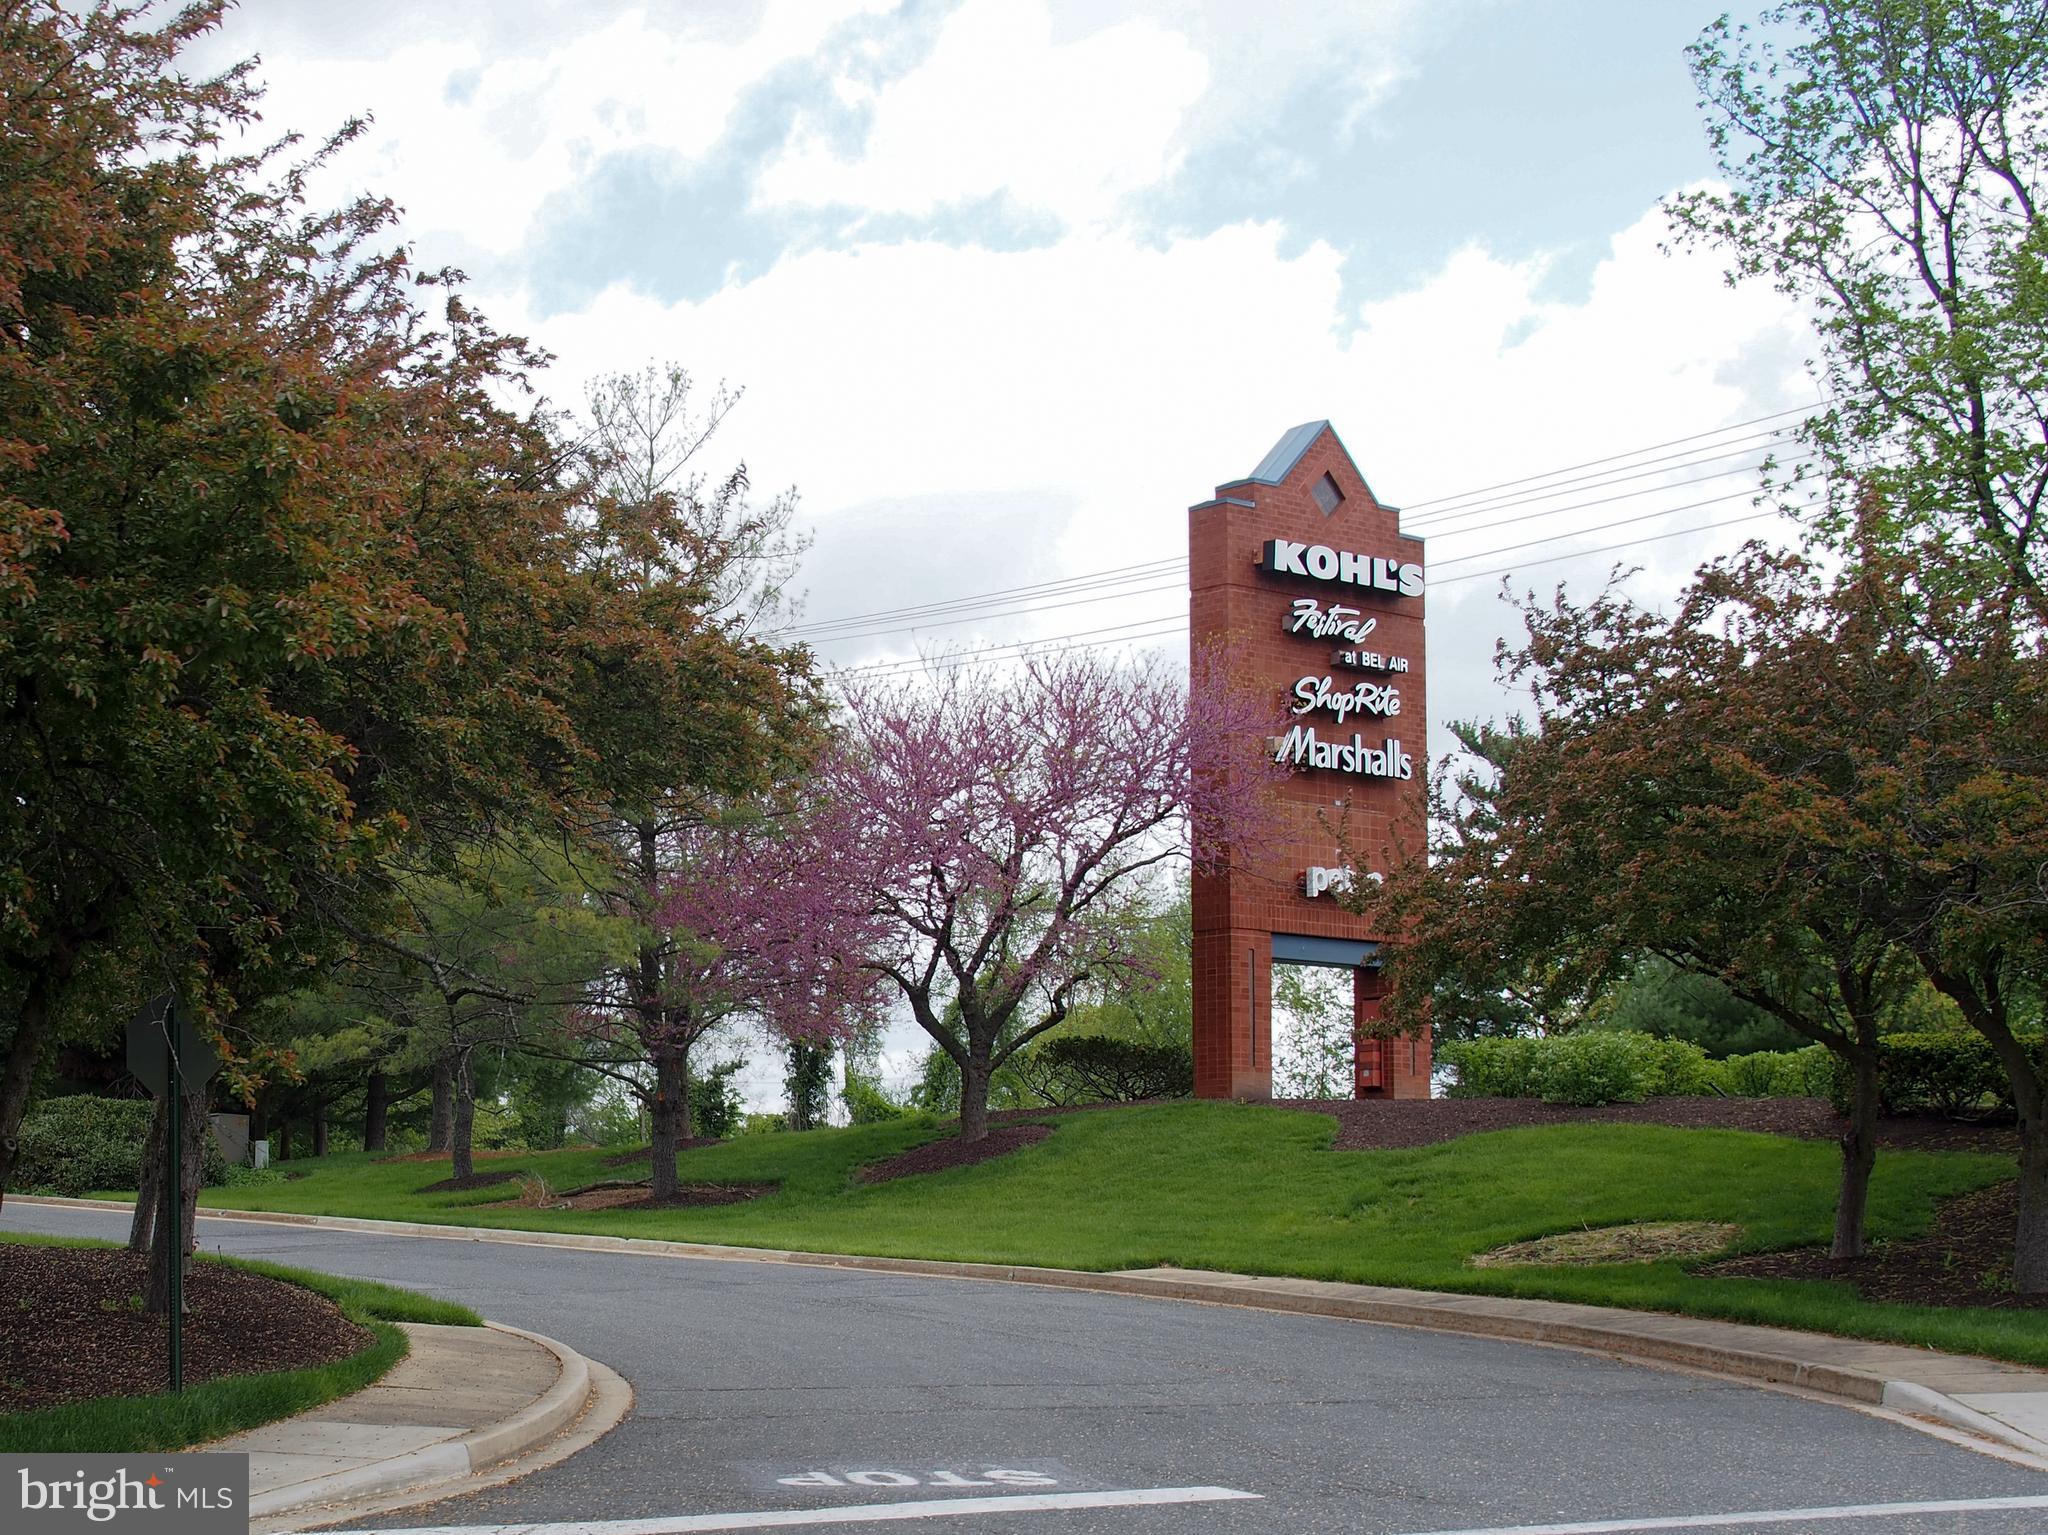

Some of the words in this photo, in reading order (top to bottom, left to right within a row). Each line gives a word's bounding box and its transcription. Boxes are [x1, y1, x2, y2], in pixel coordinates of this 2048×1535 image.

[1273, 538, 1425, 597] KOHL'S
[1292, 598, 1376, 644] Festival
[1344, 650, 1357, 665] at
[1361, 651, 1385, 669] BEL
[1388, 656, 1409, 673] AIR
[1292, 675, 1401, 724] ShopRite
[1274, 725, 1412, 780] Marshalls
[776, 1470, 1058, 1486] STOP
